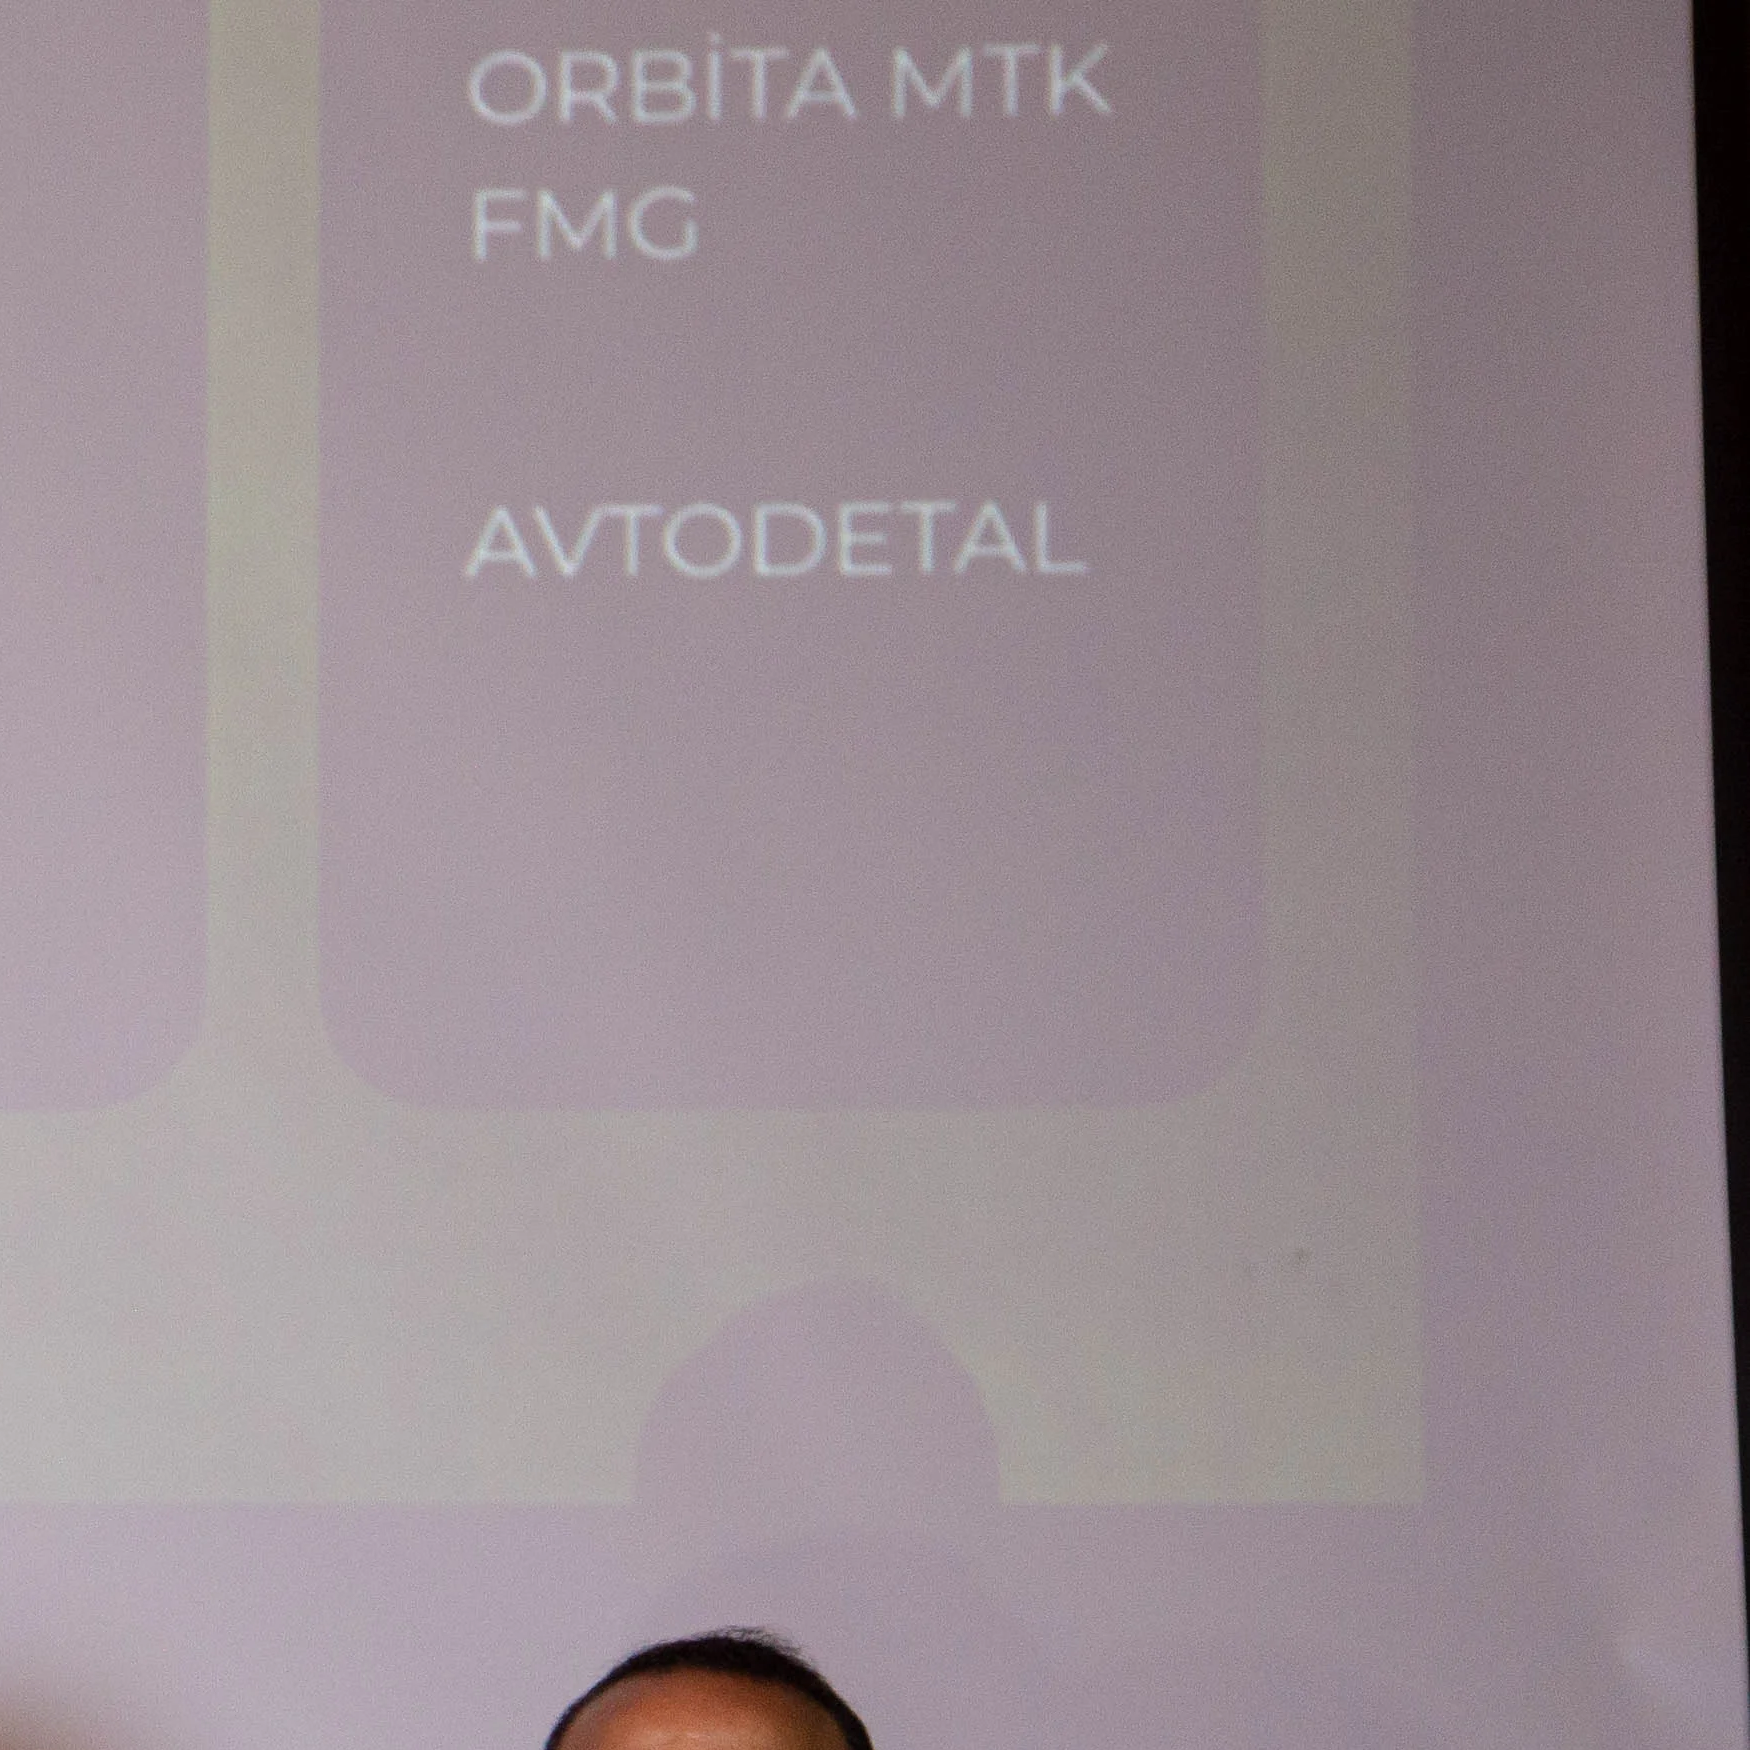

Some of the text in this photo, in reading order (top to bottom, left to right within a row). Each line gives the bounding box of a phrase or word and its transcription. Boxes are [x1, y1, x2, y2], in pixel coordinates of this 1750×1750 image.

[466, 34, 1113, 126] ORBİTA MTK
[471, 186, 700, 262] FMG
[463, 501, 1089, 579] AVTODETAL
